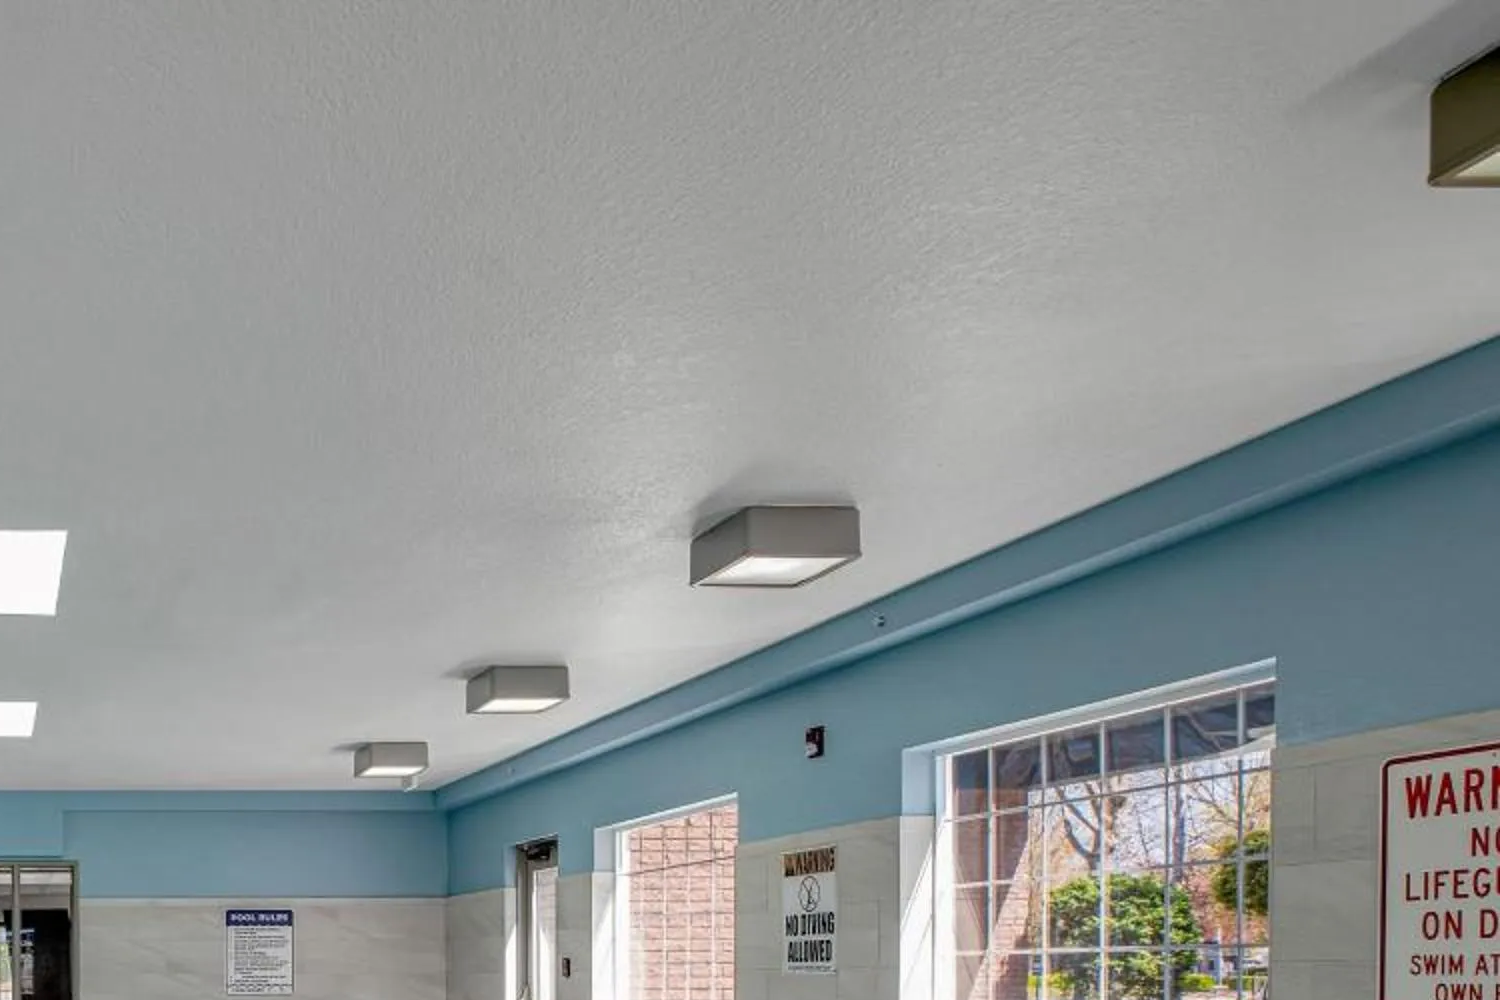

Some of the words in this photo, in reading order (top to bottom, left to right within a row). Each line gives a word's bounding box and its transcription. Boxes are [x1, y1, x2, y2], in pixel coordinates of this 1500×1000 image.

[1405, 866, 1500, 902] LIFEG
[785, 914, 798, 936] NO
[800, 911, 835, 936] DIVING
[1421, 910, 1463, 940] ON
[787, 940, 833, 962] ALLOWED
[1410, 954, 1464, 976] SWIM
